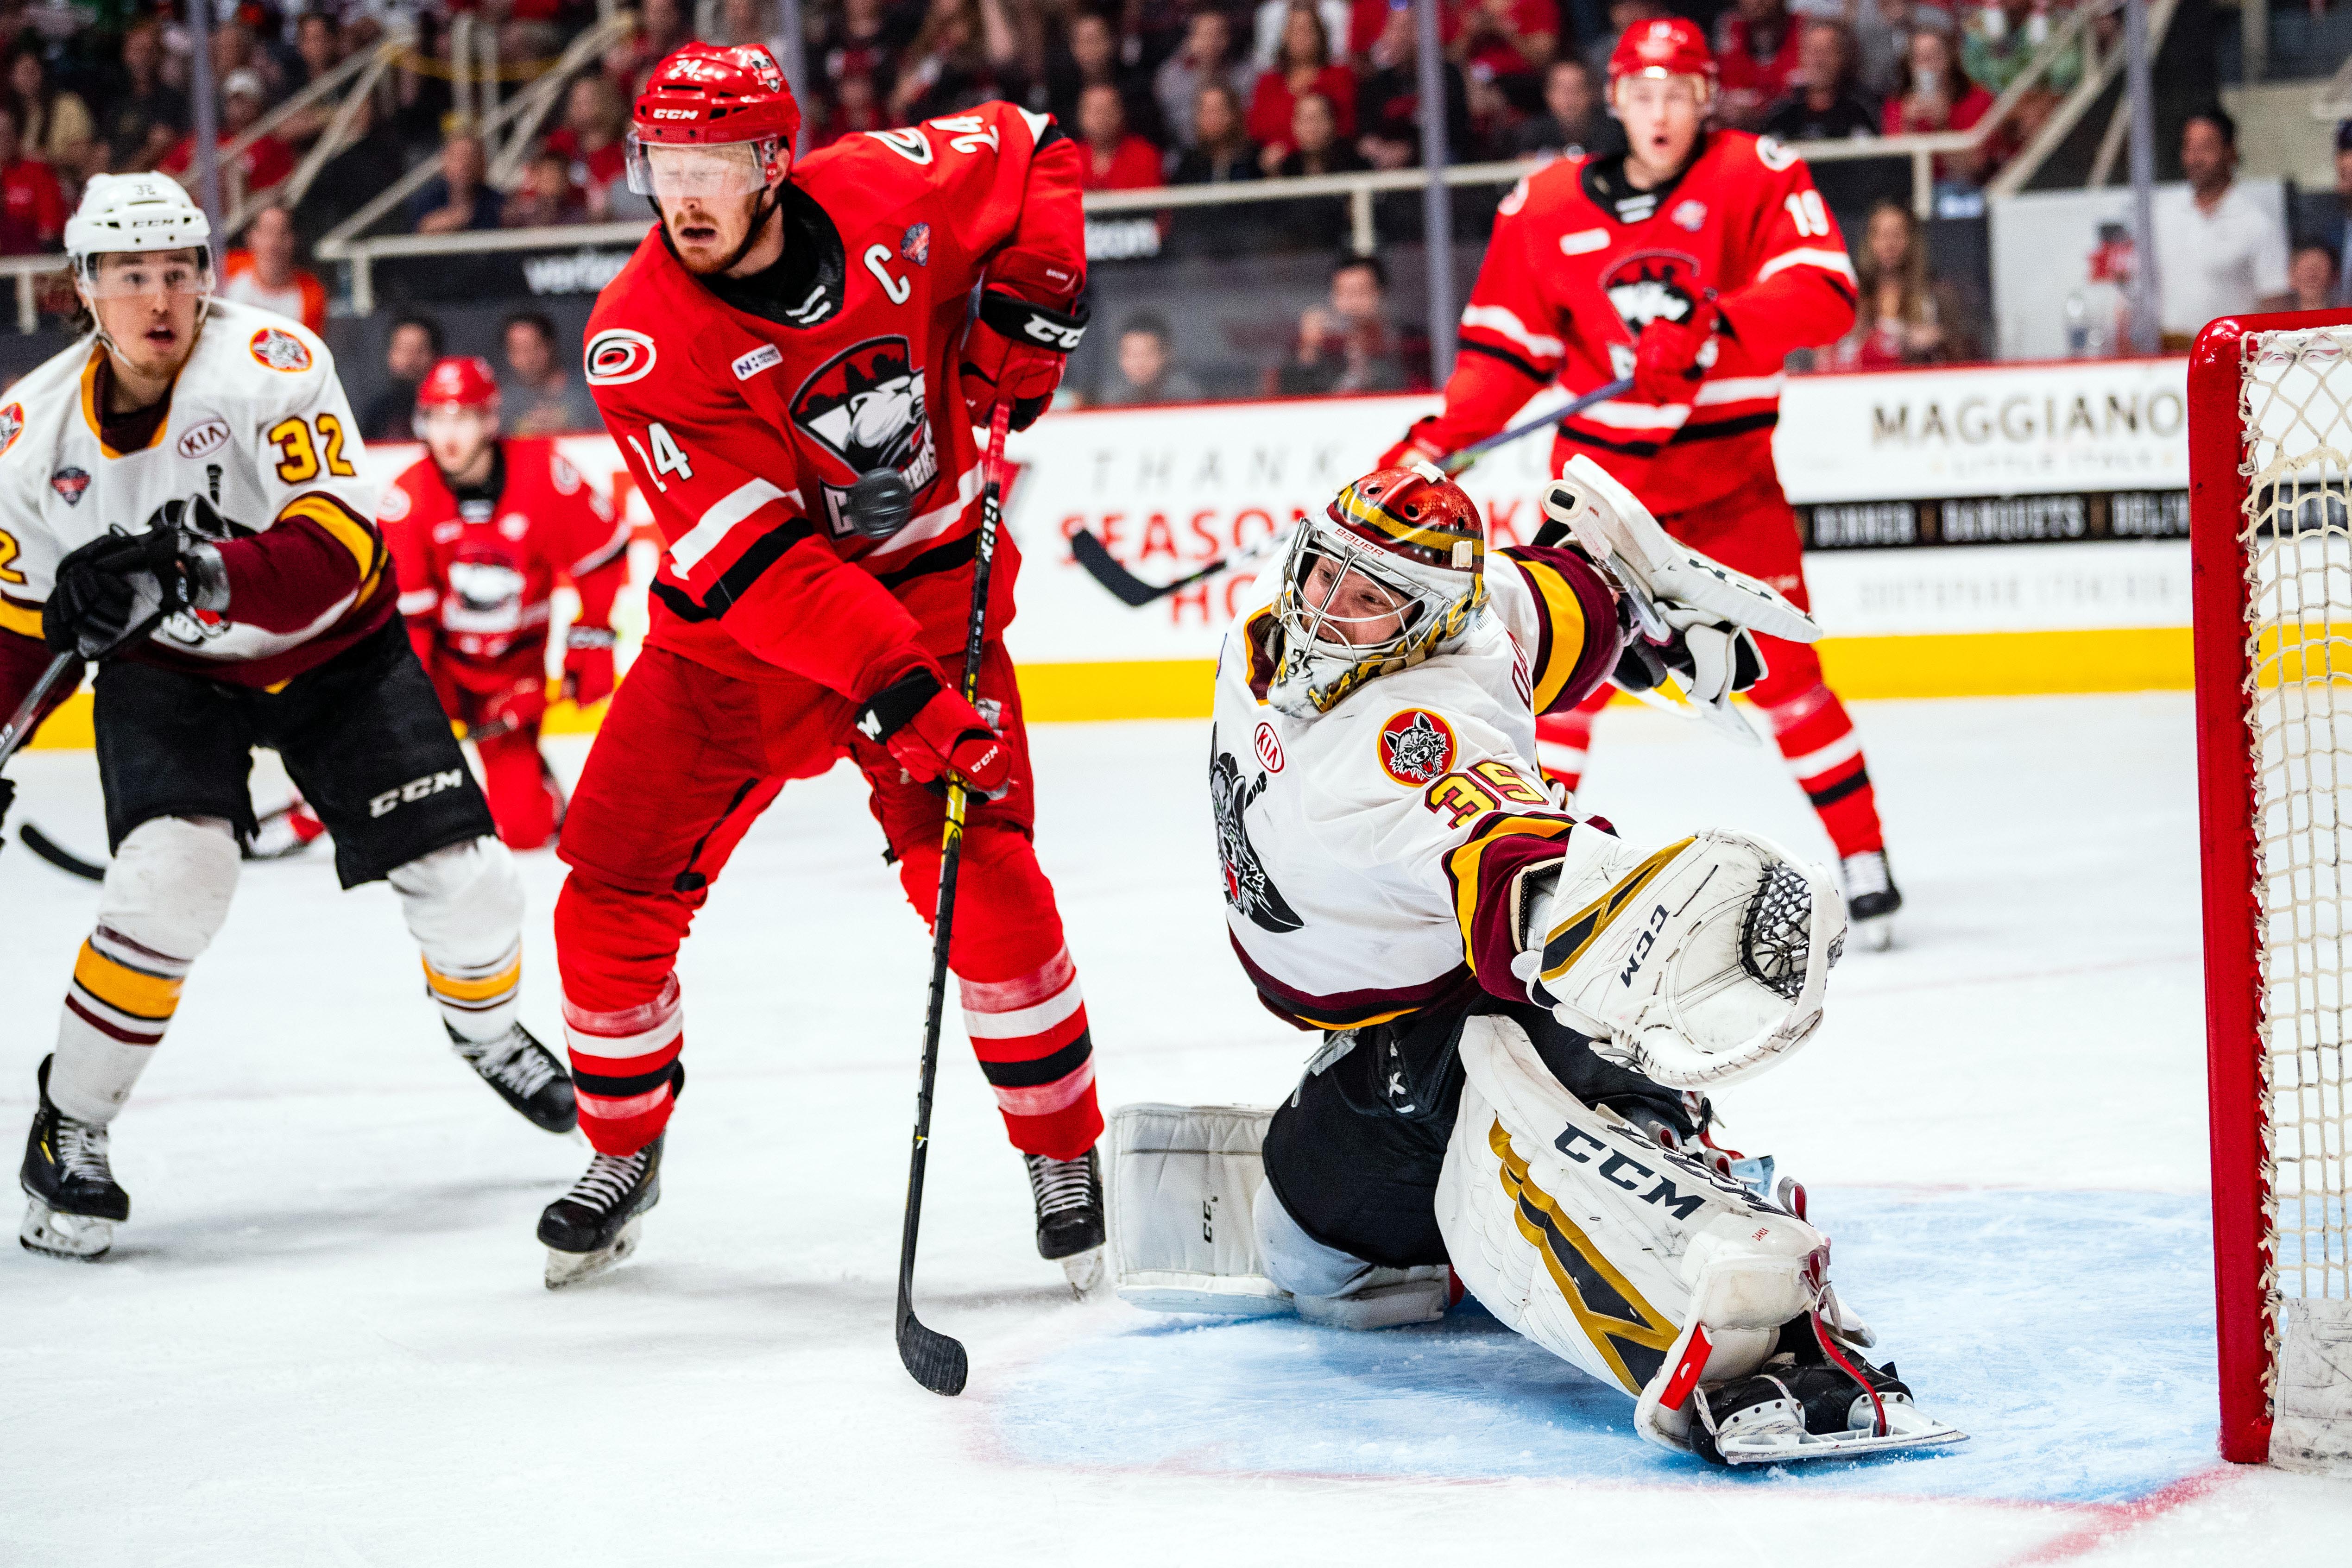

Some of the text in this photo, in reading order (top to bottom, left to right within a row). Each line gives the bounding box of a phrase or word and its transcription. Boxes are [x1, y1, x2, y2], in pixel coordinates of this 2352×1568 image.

[653, 107, 699, 120] CCM
[132, 219, 175, 228] CCM
[1784, 189, 1829, 237] 19
[864, 243, 911, 305] C
[184, 426, 225, 457] KIA
[267, 413, 357, 485] 32
[971, 744, 999, 773] CCM
[1256, 726, 1278, 769] KIA
[369, 768, 463, 819] CCM
[1425, 759, 1550, 830] 35
[1621, 904, 1671, 989] CCM
[1554, 1121, 1707, 1221] CCM
